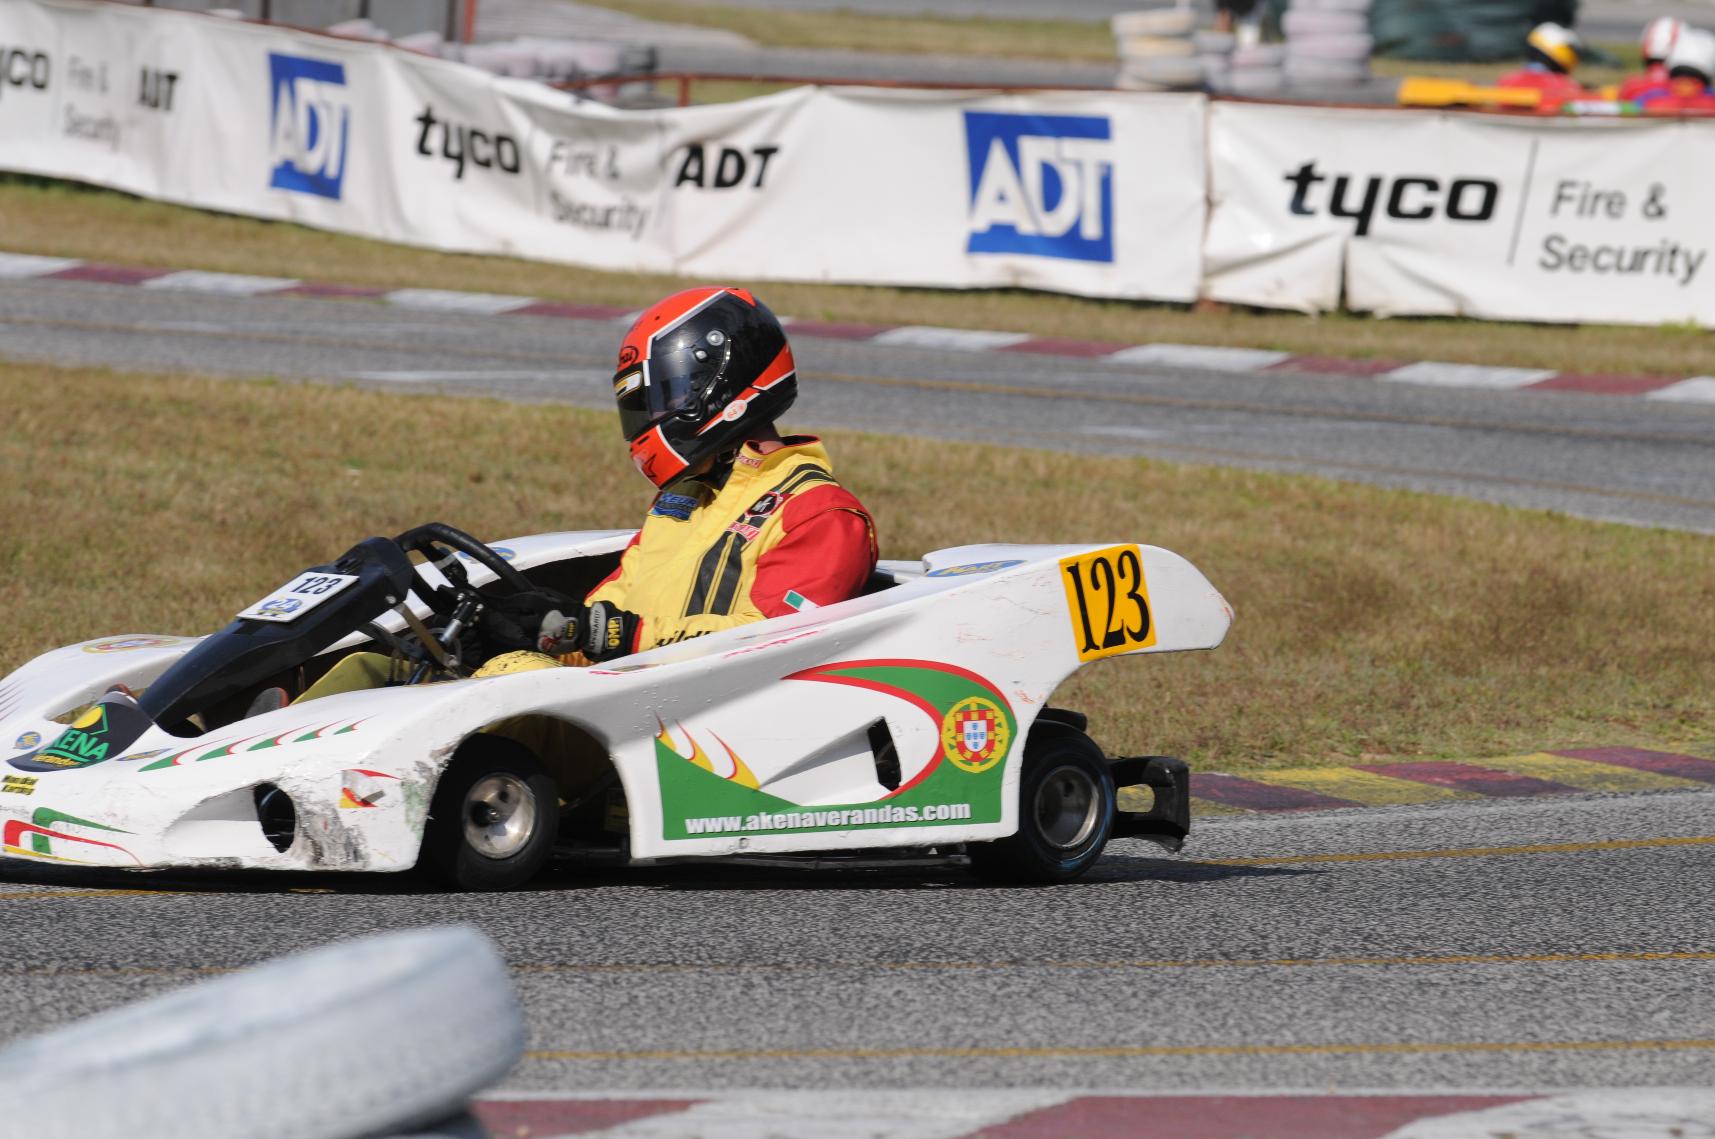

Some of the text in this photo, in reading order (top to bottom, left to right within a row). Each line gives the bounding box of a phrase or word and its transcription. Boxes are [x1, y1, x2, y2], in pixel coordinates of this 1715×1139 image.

[269, 76, 349, 180] ADT
[413, 106, 521, 179] tyco
[674, 143, 781, 188] ADT
[968, 134, 1115, 241] ADT
[1284, 159, 1501, 237] tyco
[1550, 179, 1668, 220] Fire &
[1538, 234, 1707, 286] Security
[290, 576, 342, 595] 123
[1066, 550, 1151, 654] 123
[607, 619, 621, 647] OMP
[685, 802, 971, 834] www.akenaverandas.com
